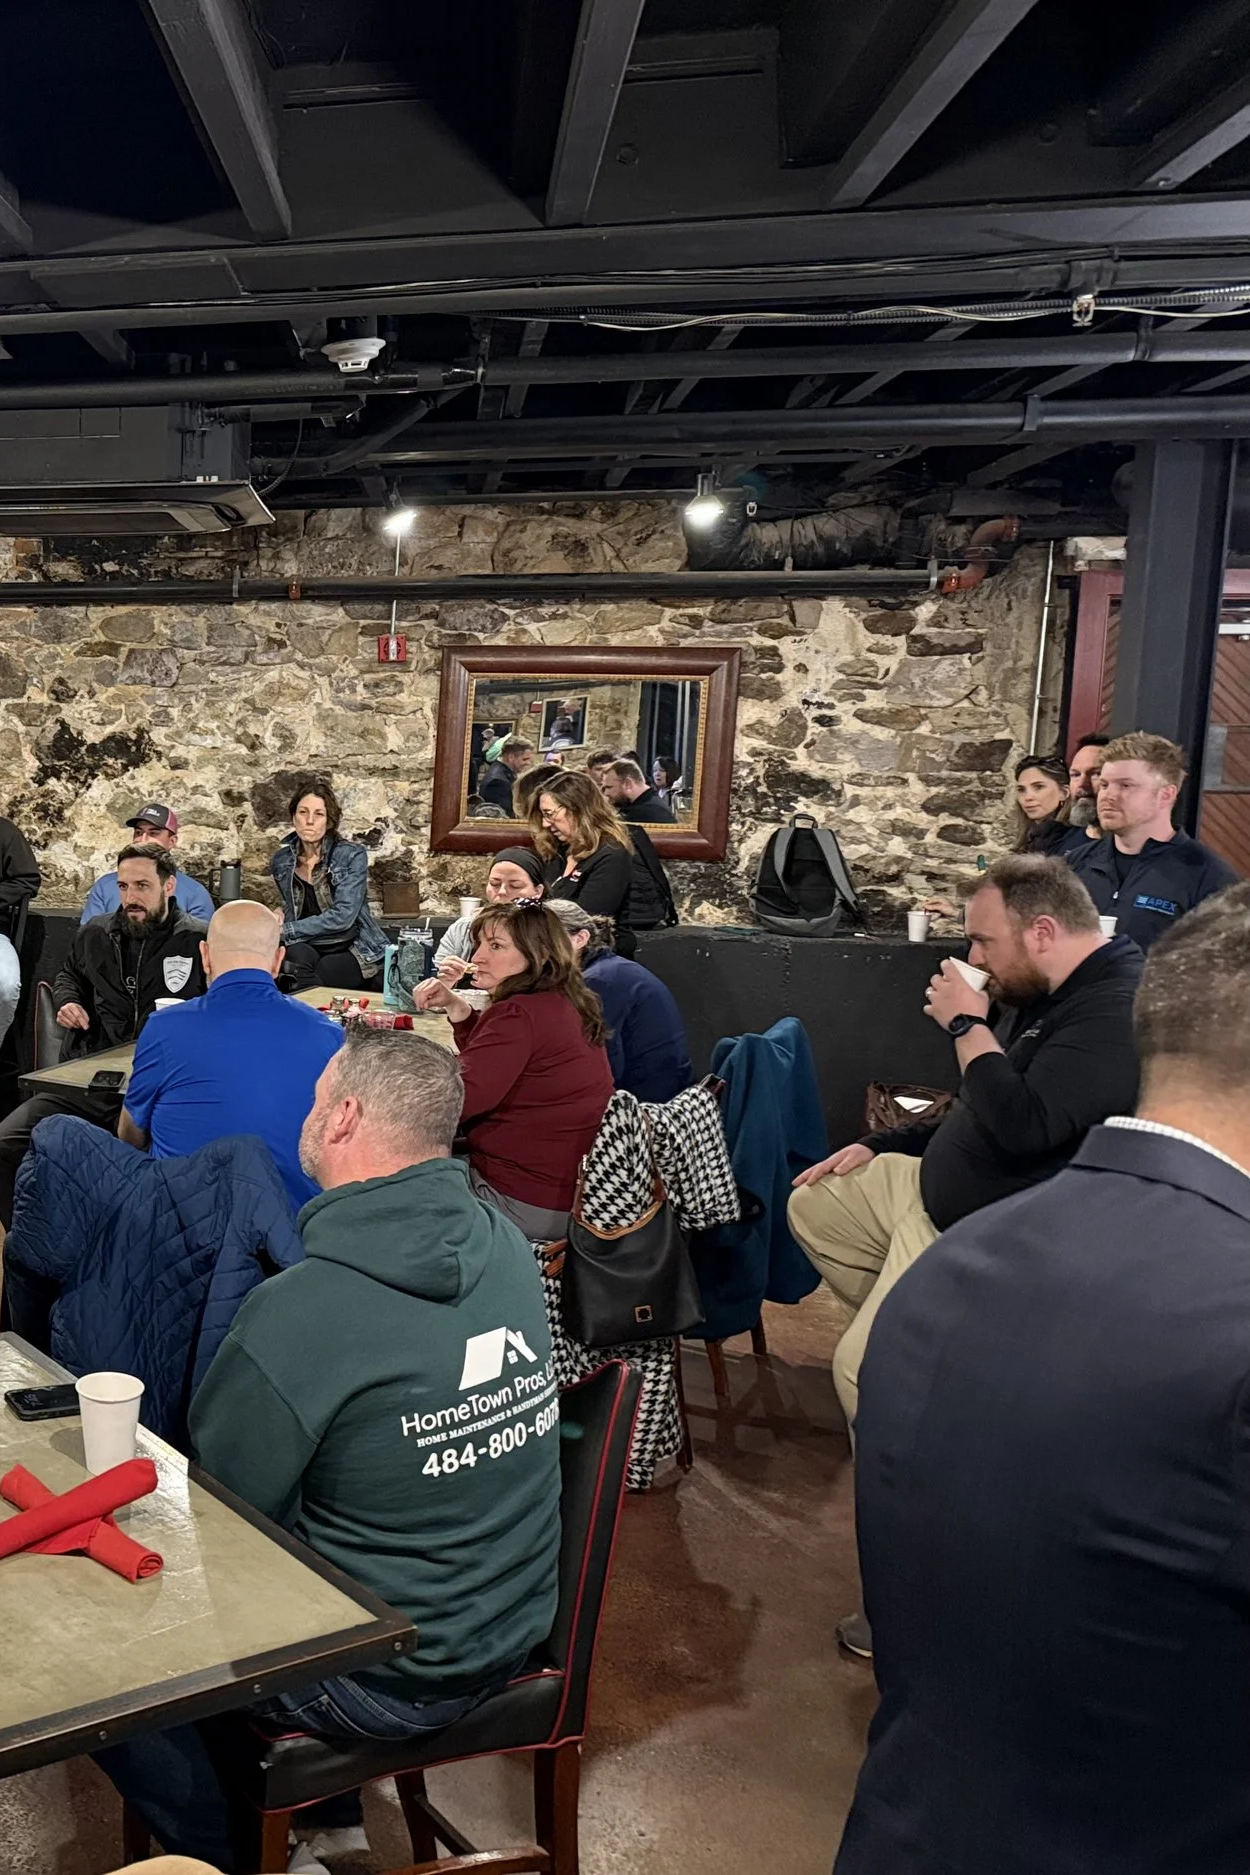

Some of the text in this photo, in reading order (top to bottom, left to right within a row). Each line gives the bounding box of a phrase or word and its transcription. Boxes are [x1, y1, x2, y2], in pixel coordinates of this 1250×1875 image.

[1147, 897, 1177, 912] APEX
[401, 1386, 513, 1437] HomeTown
[514, 1371, 547, 1398] Pros,
[416, 1392, 545, 1448] HOME MAINTENANCE & HANDYMAN
